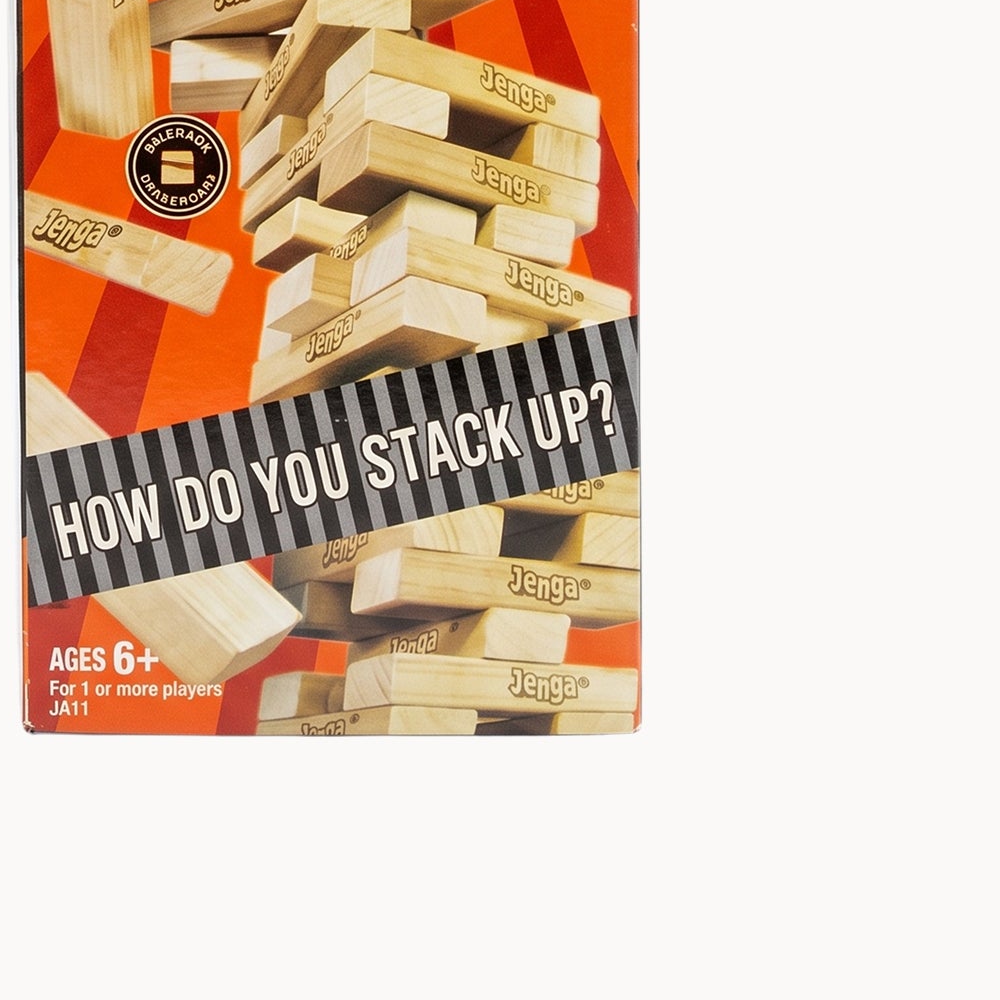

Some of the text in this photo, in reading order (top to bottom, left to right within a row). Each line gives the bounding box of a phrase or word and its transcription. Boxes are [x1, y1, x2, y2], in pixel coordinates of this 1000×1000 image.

[52, 381, 614, 558] HOW DO YOU STACK UP?
[49, 641, 159, 675] AGES 6+
[49, 680, 223, 700] For 1 or more players
[49, 700, 89, 716] JA11
